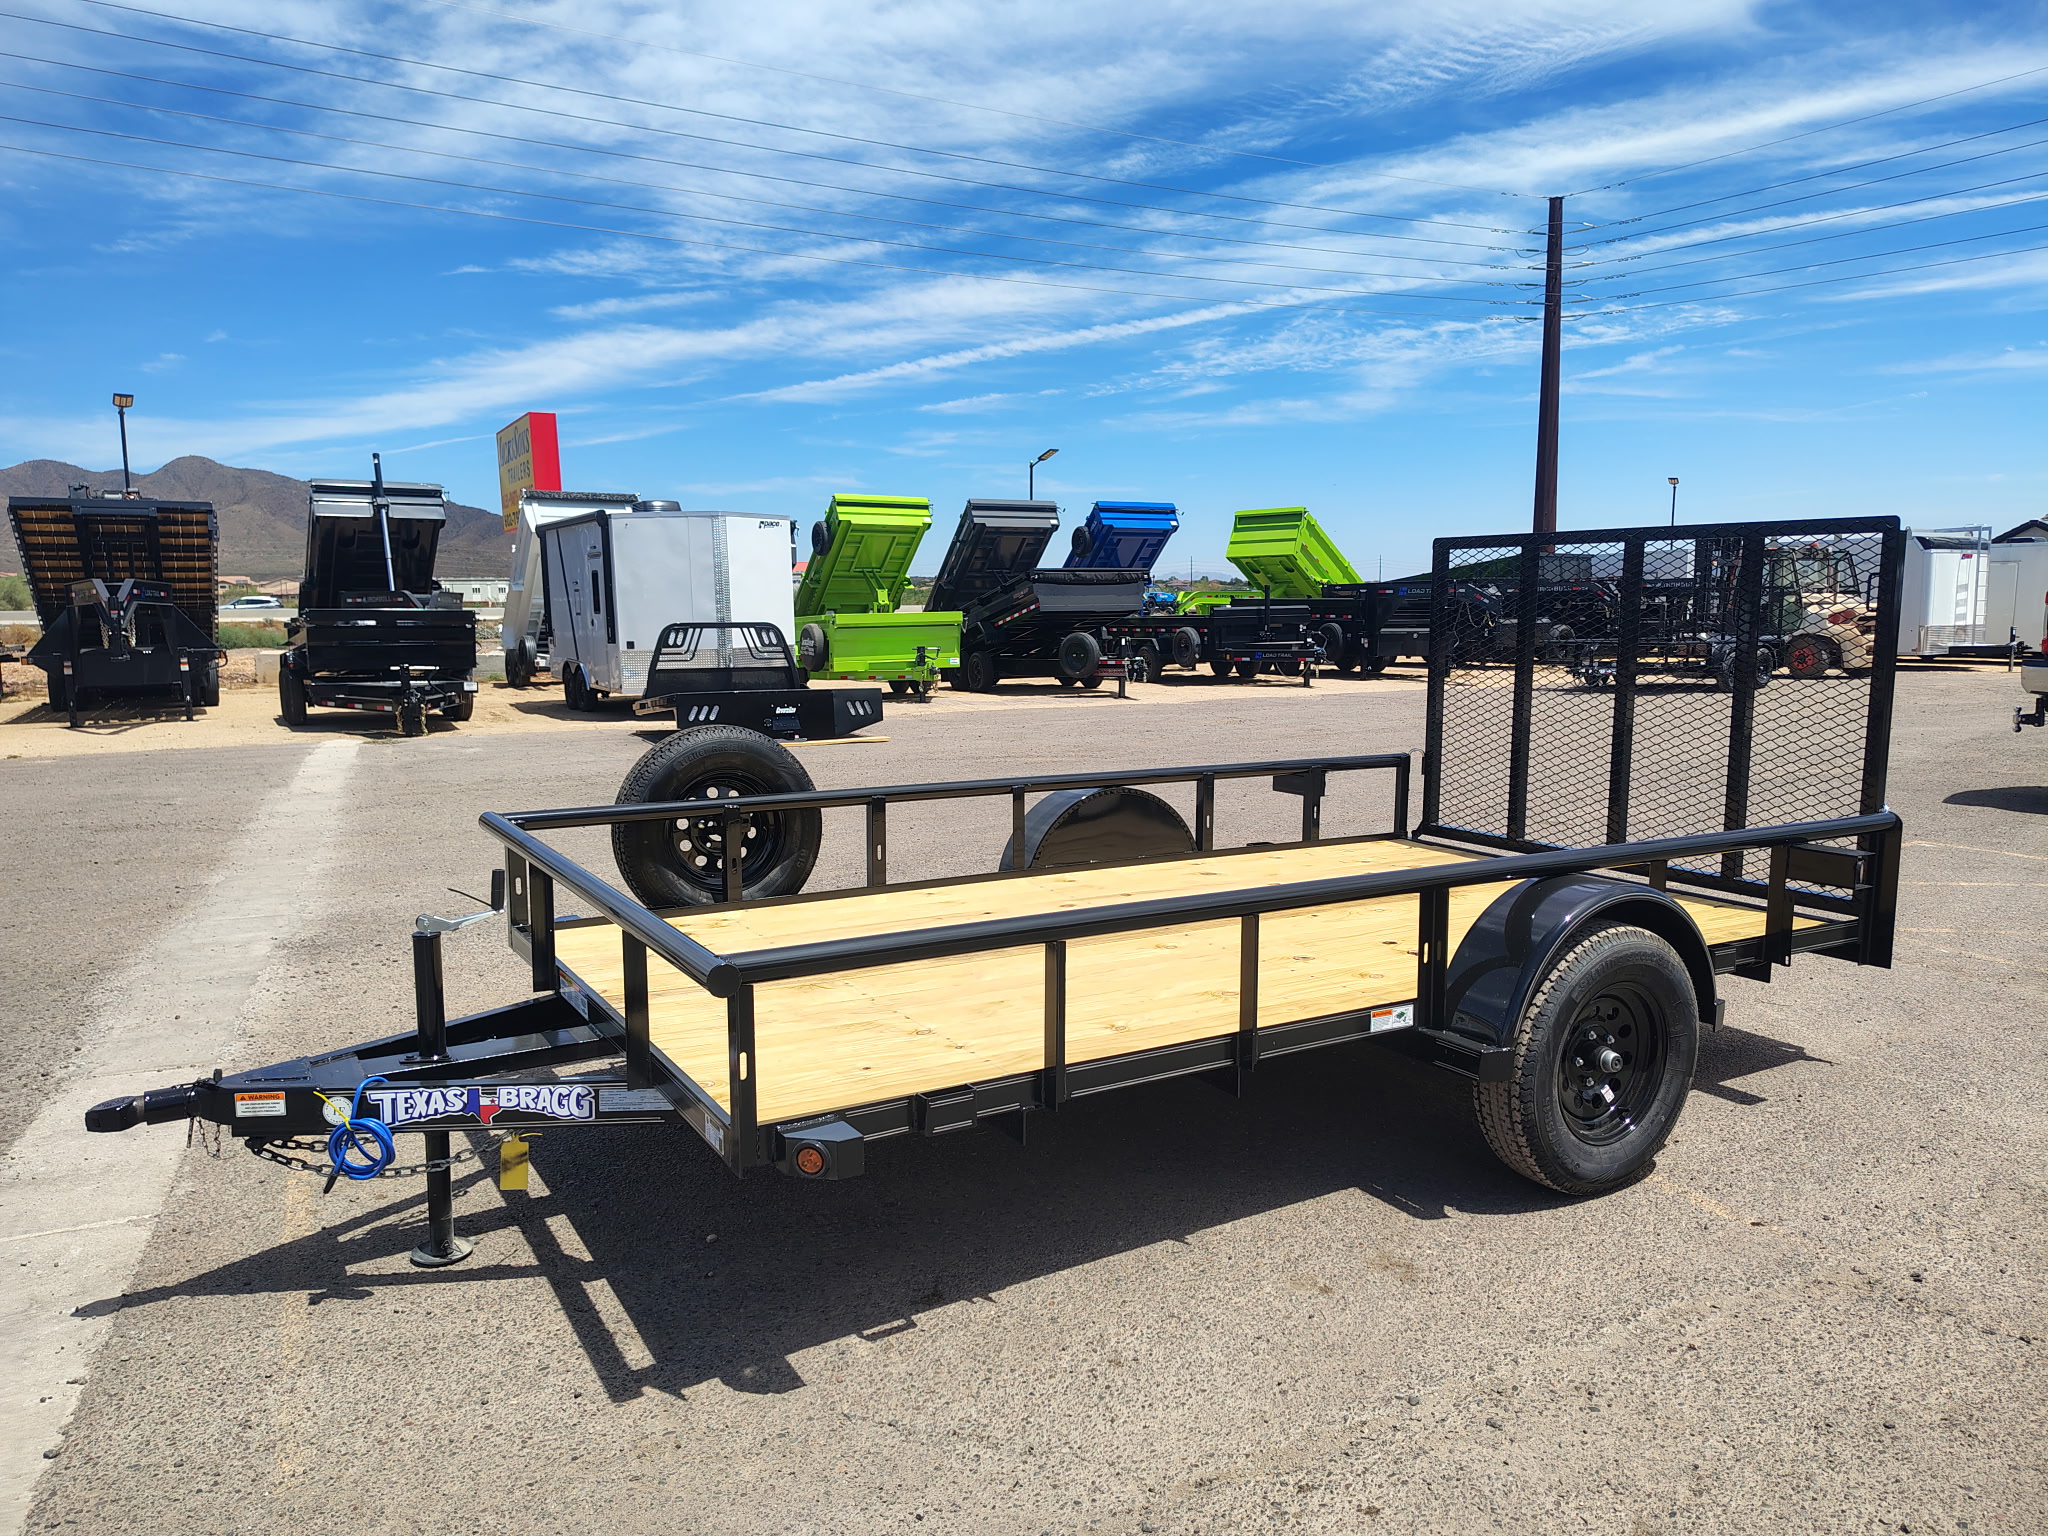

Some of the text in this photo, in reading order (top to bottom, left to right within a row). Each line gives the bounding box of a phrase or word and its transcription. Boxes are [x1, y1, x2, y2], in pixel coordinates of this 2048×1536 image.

[508, 460, 530, 484] TRAILERS
[247, 1093, 280, 1101] WARNING
[369, 1088, 466, 1125] TEXAS
[498, 1086, 594, 1120] BRAGG
